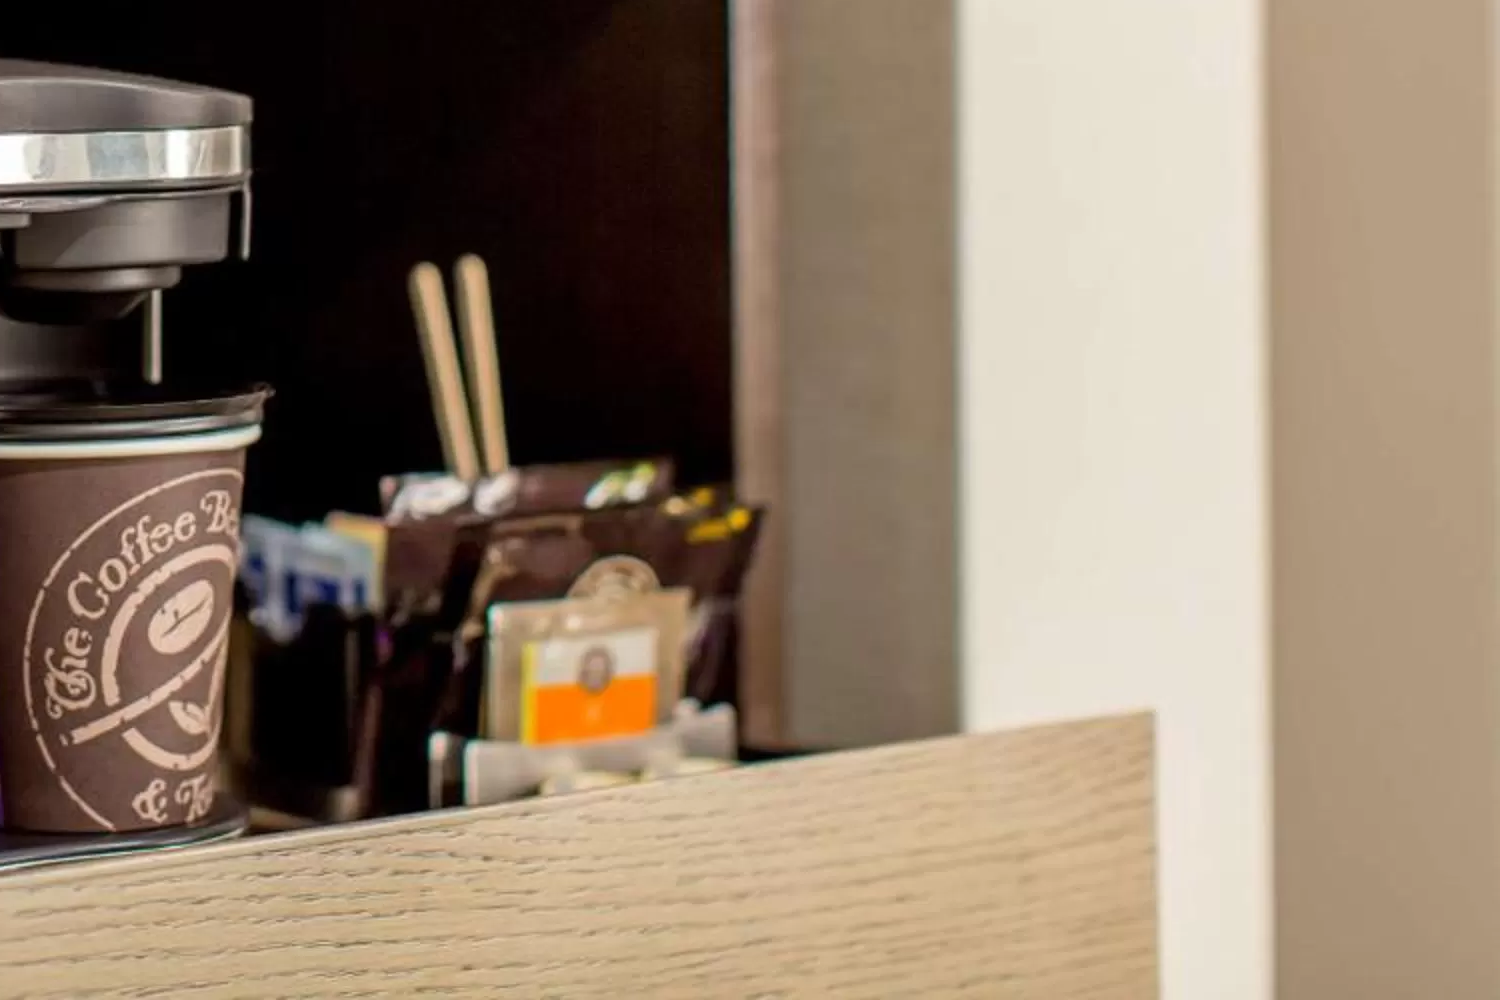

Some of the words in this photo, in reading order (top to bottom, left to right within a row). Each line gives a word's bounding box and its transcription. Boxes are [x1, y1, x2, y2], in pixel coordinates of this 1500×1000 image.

[200, 489, 238, 537] Be
[67, 509, 198, 621] Coffee
[44, 628, 97, 720] The
[131, 777, 169, 824] &
[173, 773, 213, 824] Te
